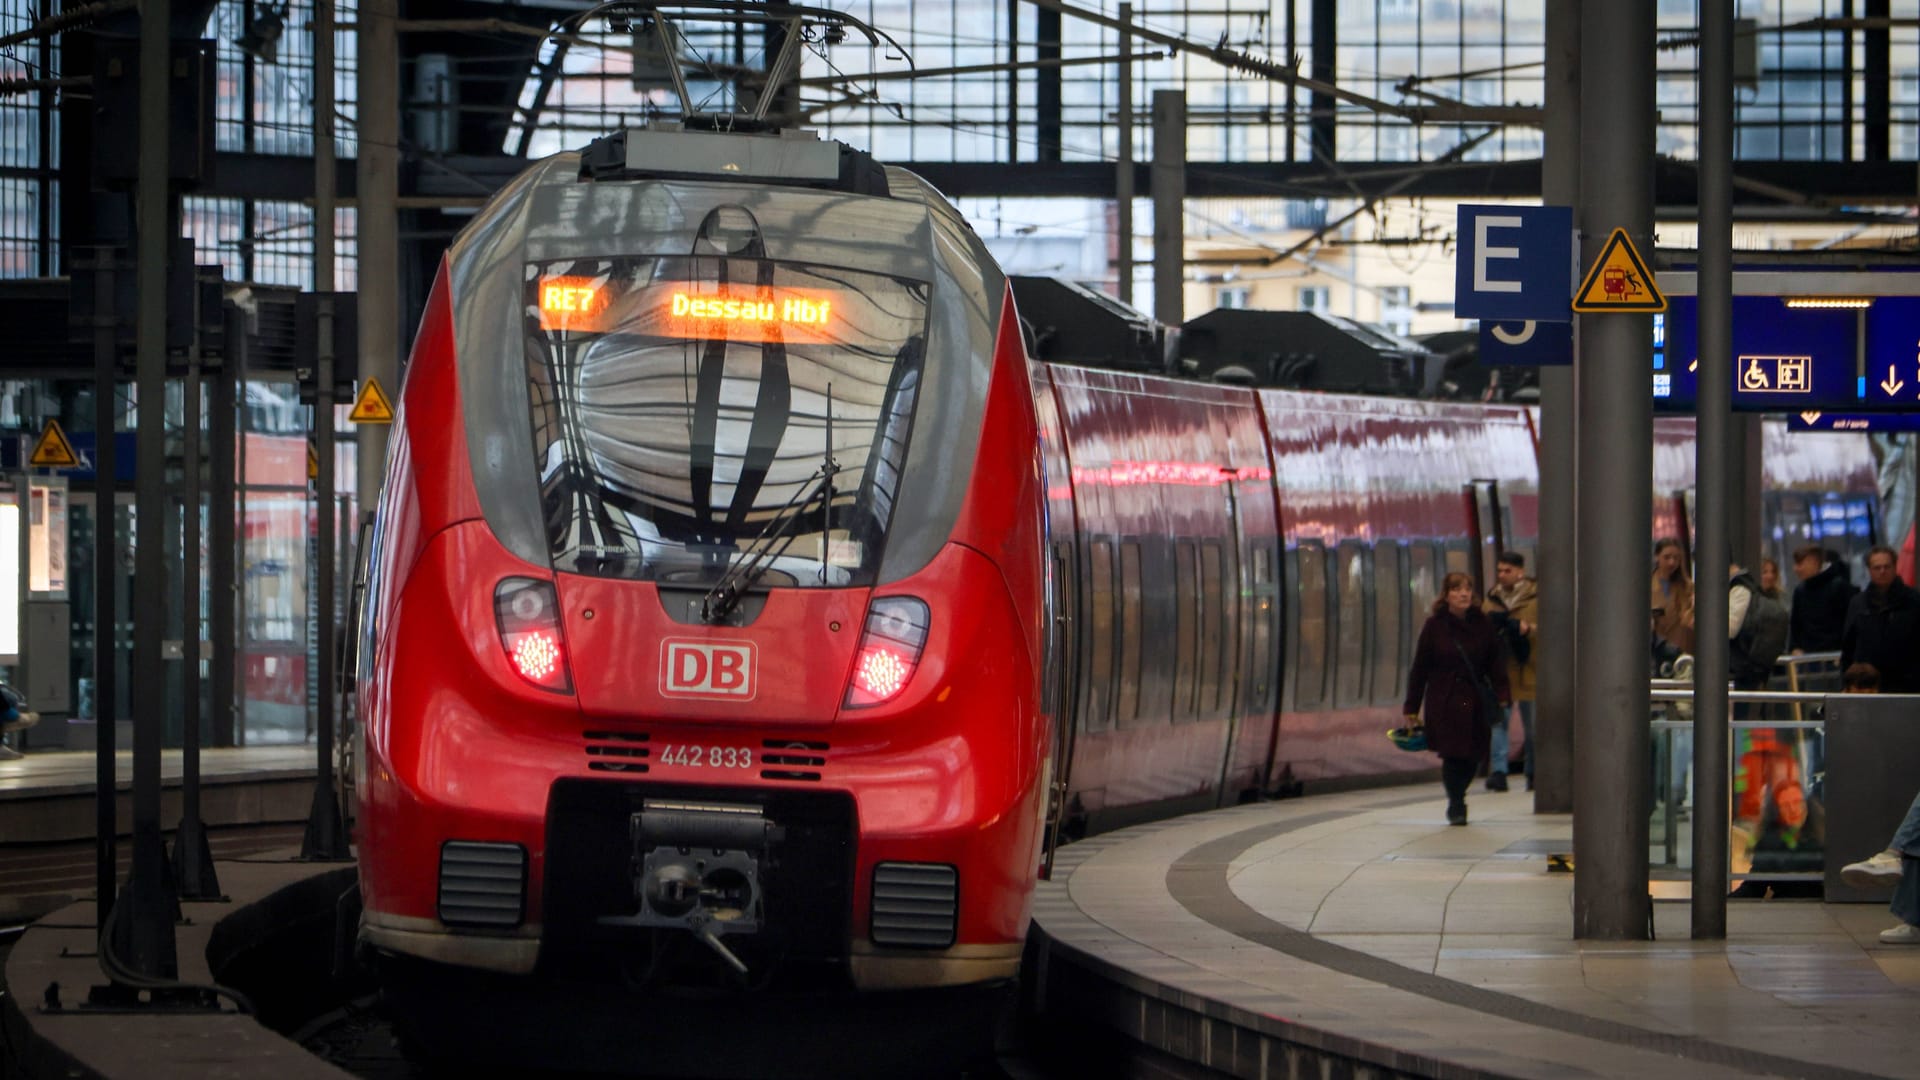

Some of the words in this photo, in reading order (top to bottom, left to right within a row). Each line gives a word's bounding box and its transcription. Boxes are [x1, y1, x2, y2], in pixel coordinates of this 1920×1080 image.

[1474, 215, 1522, 293] E
[544, 286, 594, 311] RE7
[672, 293, 774, 320] Dessau
[784, 299, 830, 323] Hbf
[673, 647, 745, 690] DB
[661, 744, 702, 767] 442
[709, 746, 752, 769] 833
